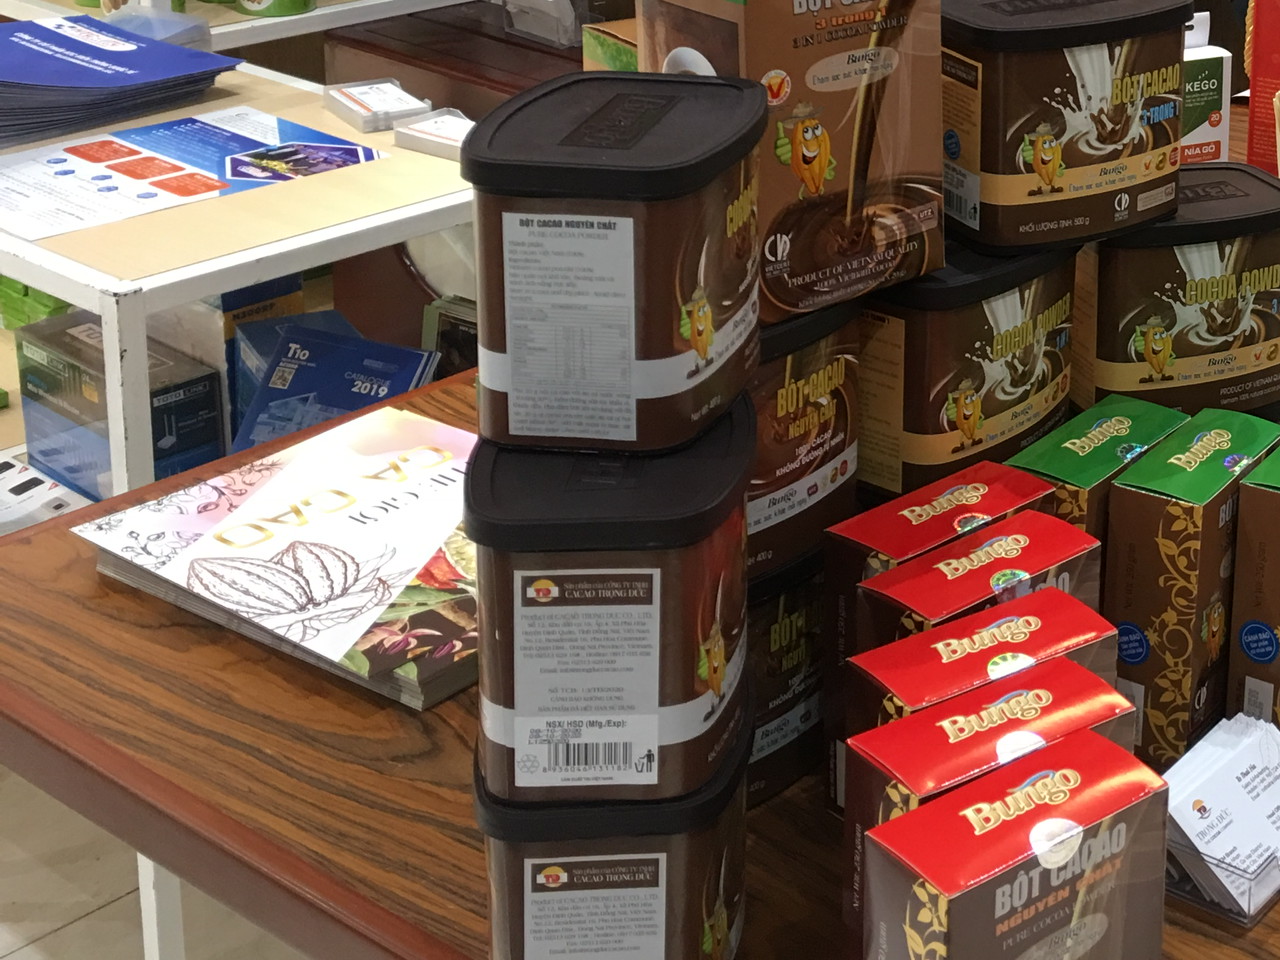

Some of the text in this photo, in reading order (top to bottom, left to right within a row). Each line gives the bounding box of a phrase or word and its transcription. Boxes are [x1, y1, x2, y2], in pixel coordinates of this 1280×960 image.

[1112, 63, 1181, 106] BỘT CACAO
[1185, 79, 1218, 92] KEGO
[1150, 103, 1174, 124] TRONG
[1099, 164, 1128, 177] Bungo
[519, 218, 617, 231] BỘT CACAO NGUYÊN CHẤT
[919, 208, 933, 220] UTZ
[788, 241, 918, 287] PRODUCT OF VIETNAM QUALITY
[838, 268, 871, 286] Vietnam
[1185, 274, 1237, 306] COCOA
[1272, 299, 1277, 313] 3
[993, 292, 1070, 361] COCOA POWDER
[288, 343, 310, 360] T10
[1208, 354, 1236, 366] Bungo
[344, 371, 391, 387] CATALOGUE
[351, 381, 388, 398] 2019
[777, 356, 845, 418] BỘT CACAO
[1220, 383, 1244, 396] PRODUCT
[1245, 381, 1251, 391] OF
[1251, 377, 1271, 389] VIETNAM
[157, 392, 180, 404] TOTO
[788, 411, 819, 440] NGUYÊN
[1061, 416, 1133, 456] Bungo
[810, 430, 832, 448] CACAO
[1167, 429, 1232, 472] Bungo
[776, 458, 801, 477] KHÔNG
[768, 487, 797, 509] Bungo
[898, 483, 988, 525] Bungo
[933, 534, 1029, 580] Bungo
[565, 590, 596, 598] CACAO
[598, 589, 627, 599] TRỌNG
[770, 614, 797, 652] BỘT
[931, 616, 1041, 663] Bungo
[546, 720, 627, 729] NSX/ HSD (Mfg./Exp):
[935, 689, 1052, 743] Bungo
[958, 768, 1081, 835] Bungo
[574, 874, 603, 883] CACAO
[606, 873, 634, 883] TRỌNG
[995, 822, 1127, 919] BỘT CACAO
[995, 856, 1123, 936] NGUYÊN CHẤT
[1003, 929, 1031, 950] PURE
[1033, 909, 1071, 934] COCOA
